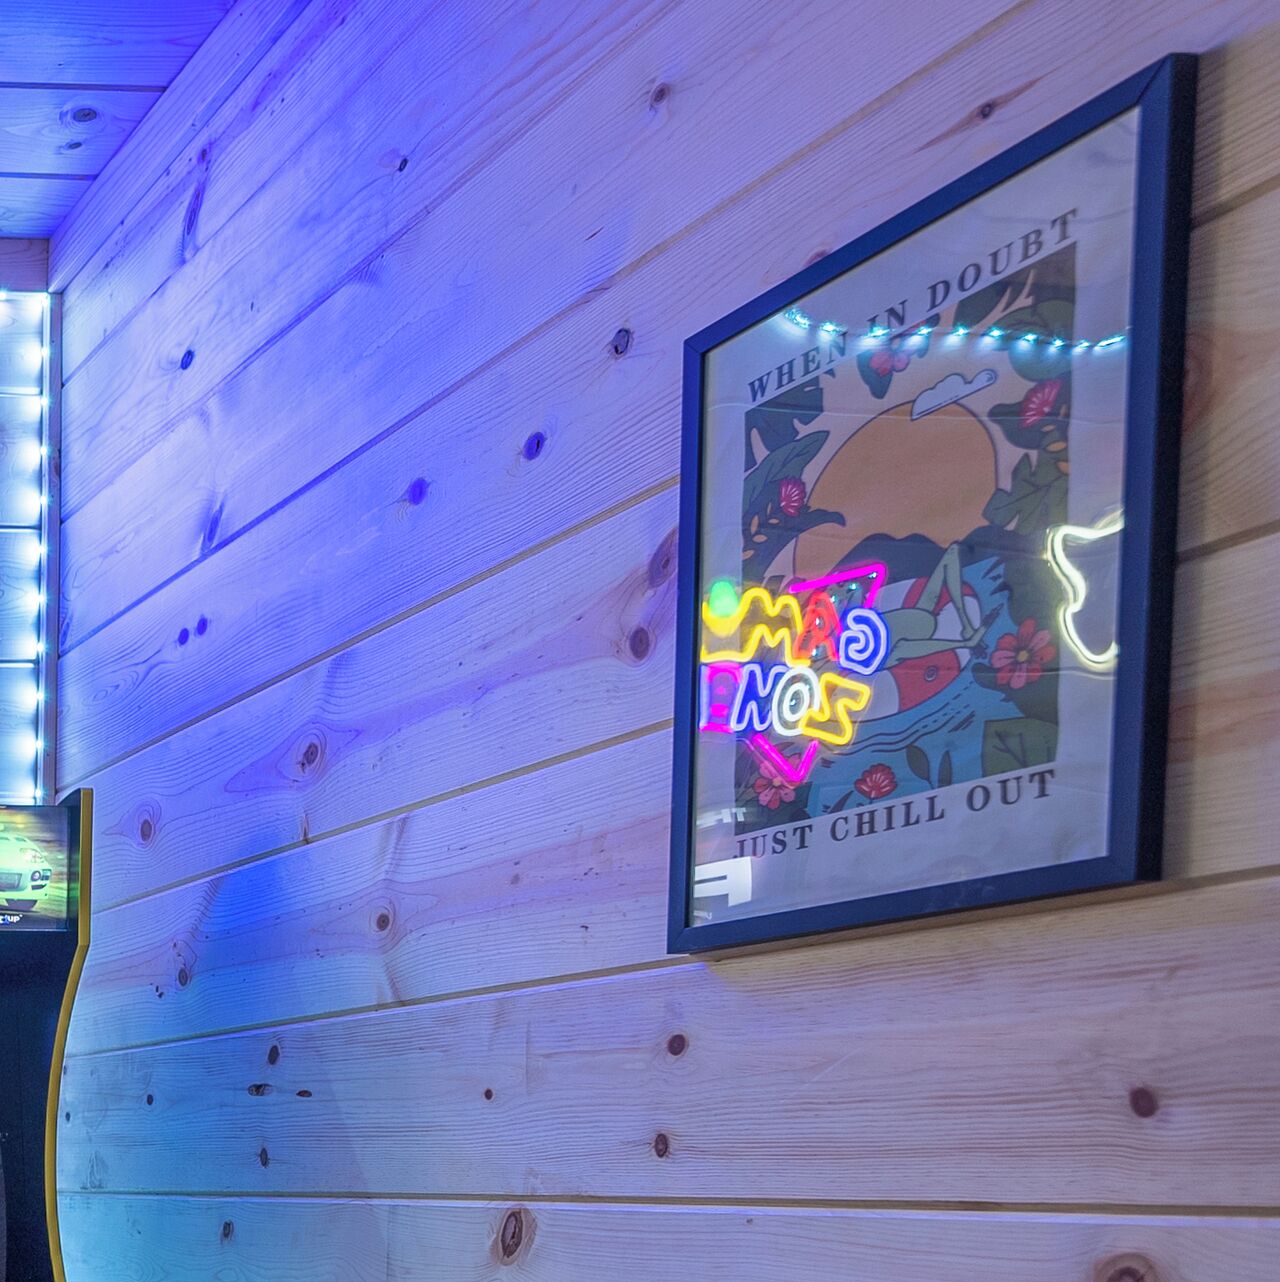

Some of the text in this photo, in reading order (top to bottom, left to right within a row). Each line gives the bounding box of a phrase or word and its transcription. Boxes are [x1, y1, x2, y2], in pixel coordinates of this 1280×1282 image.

[746, 207, 1079, 403] WHEN IN DOUBT
[732, 768, 1057, 860] JUST CHILL OUT
